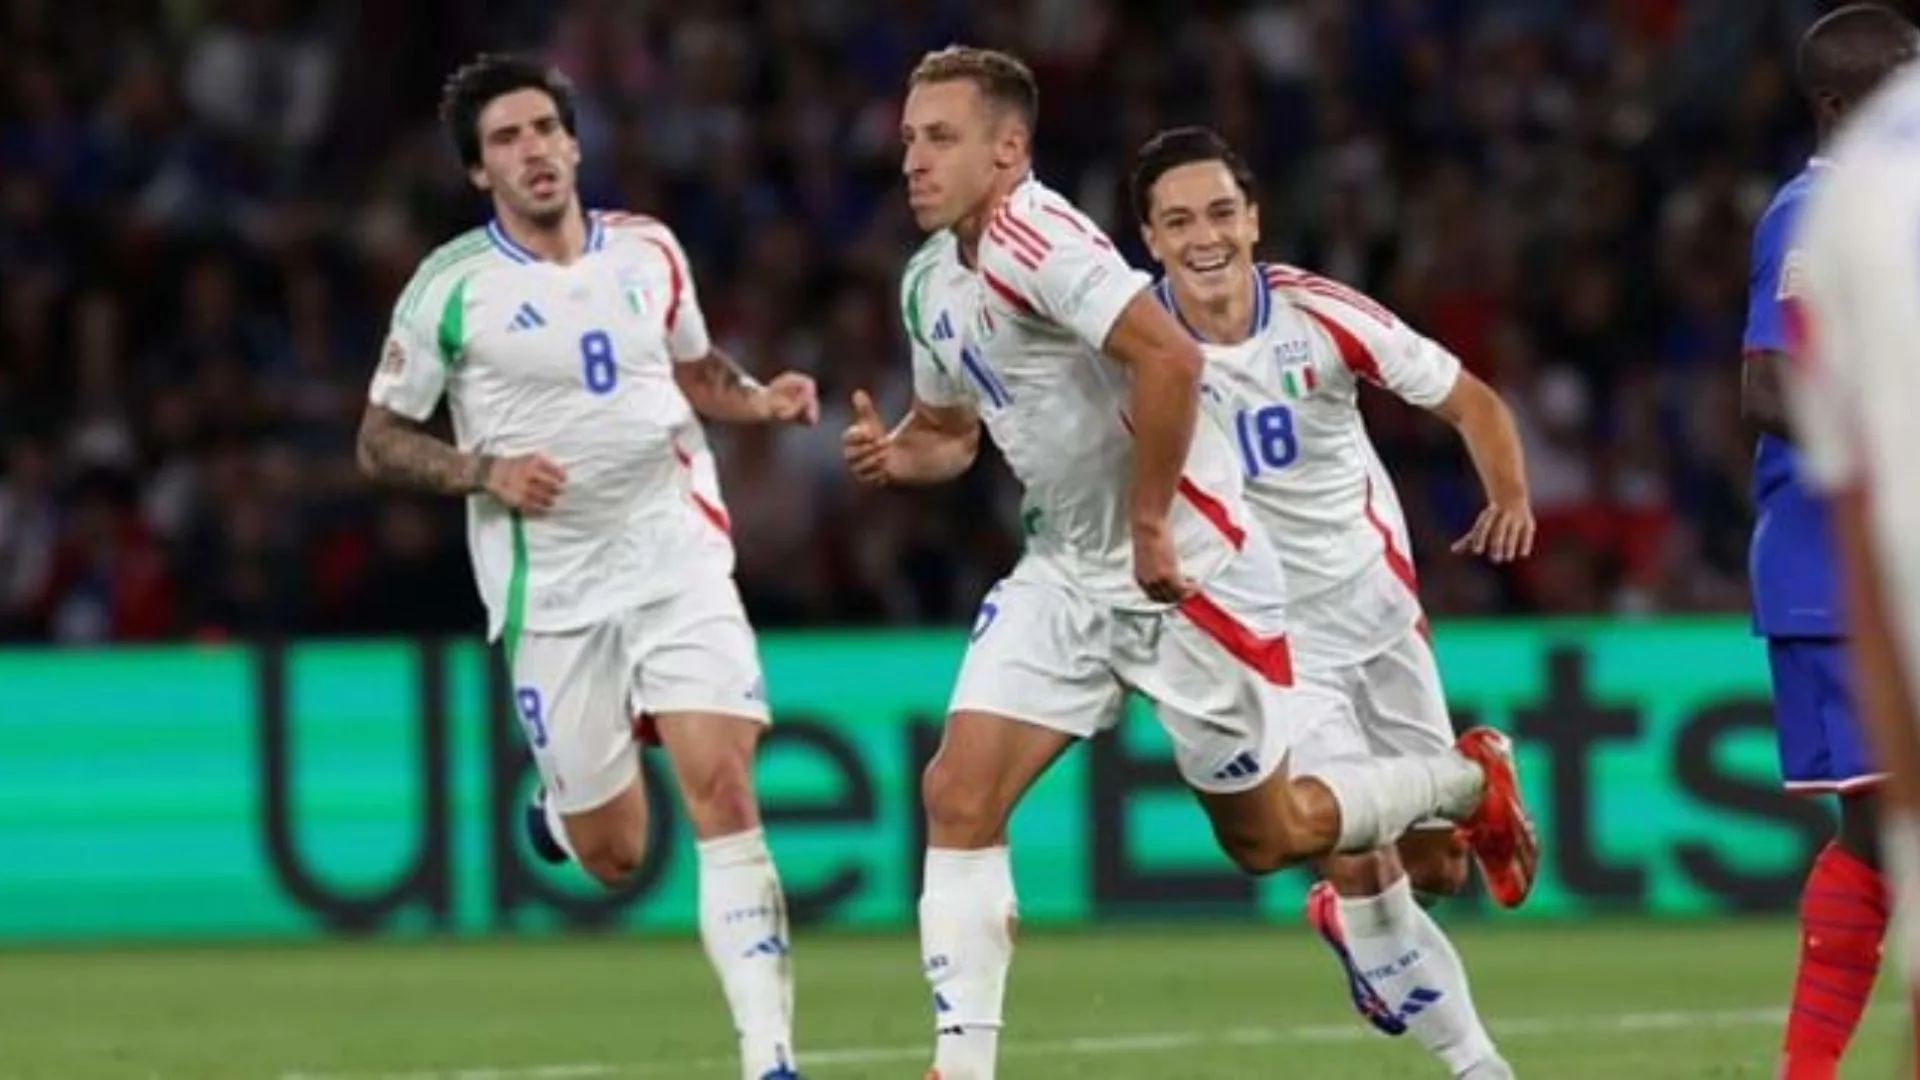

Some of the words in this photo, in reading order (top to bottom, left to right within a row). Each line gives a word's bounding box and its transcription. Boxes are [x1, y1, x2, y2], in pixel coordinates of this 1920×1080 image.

[580, 329, 617, 394] 8
[1236, 405, 1298, 478] 18
[1087, 645, 1846, 918] Ets
